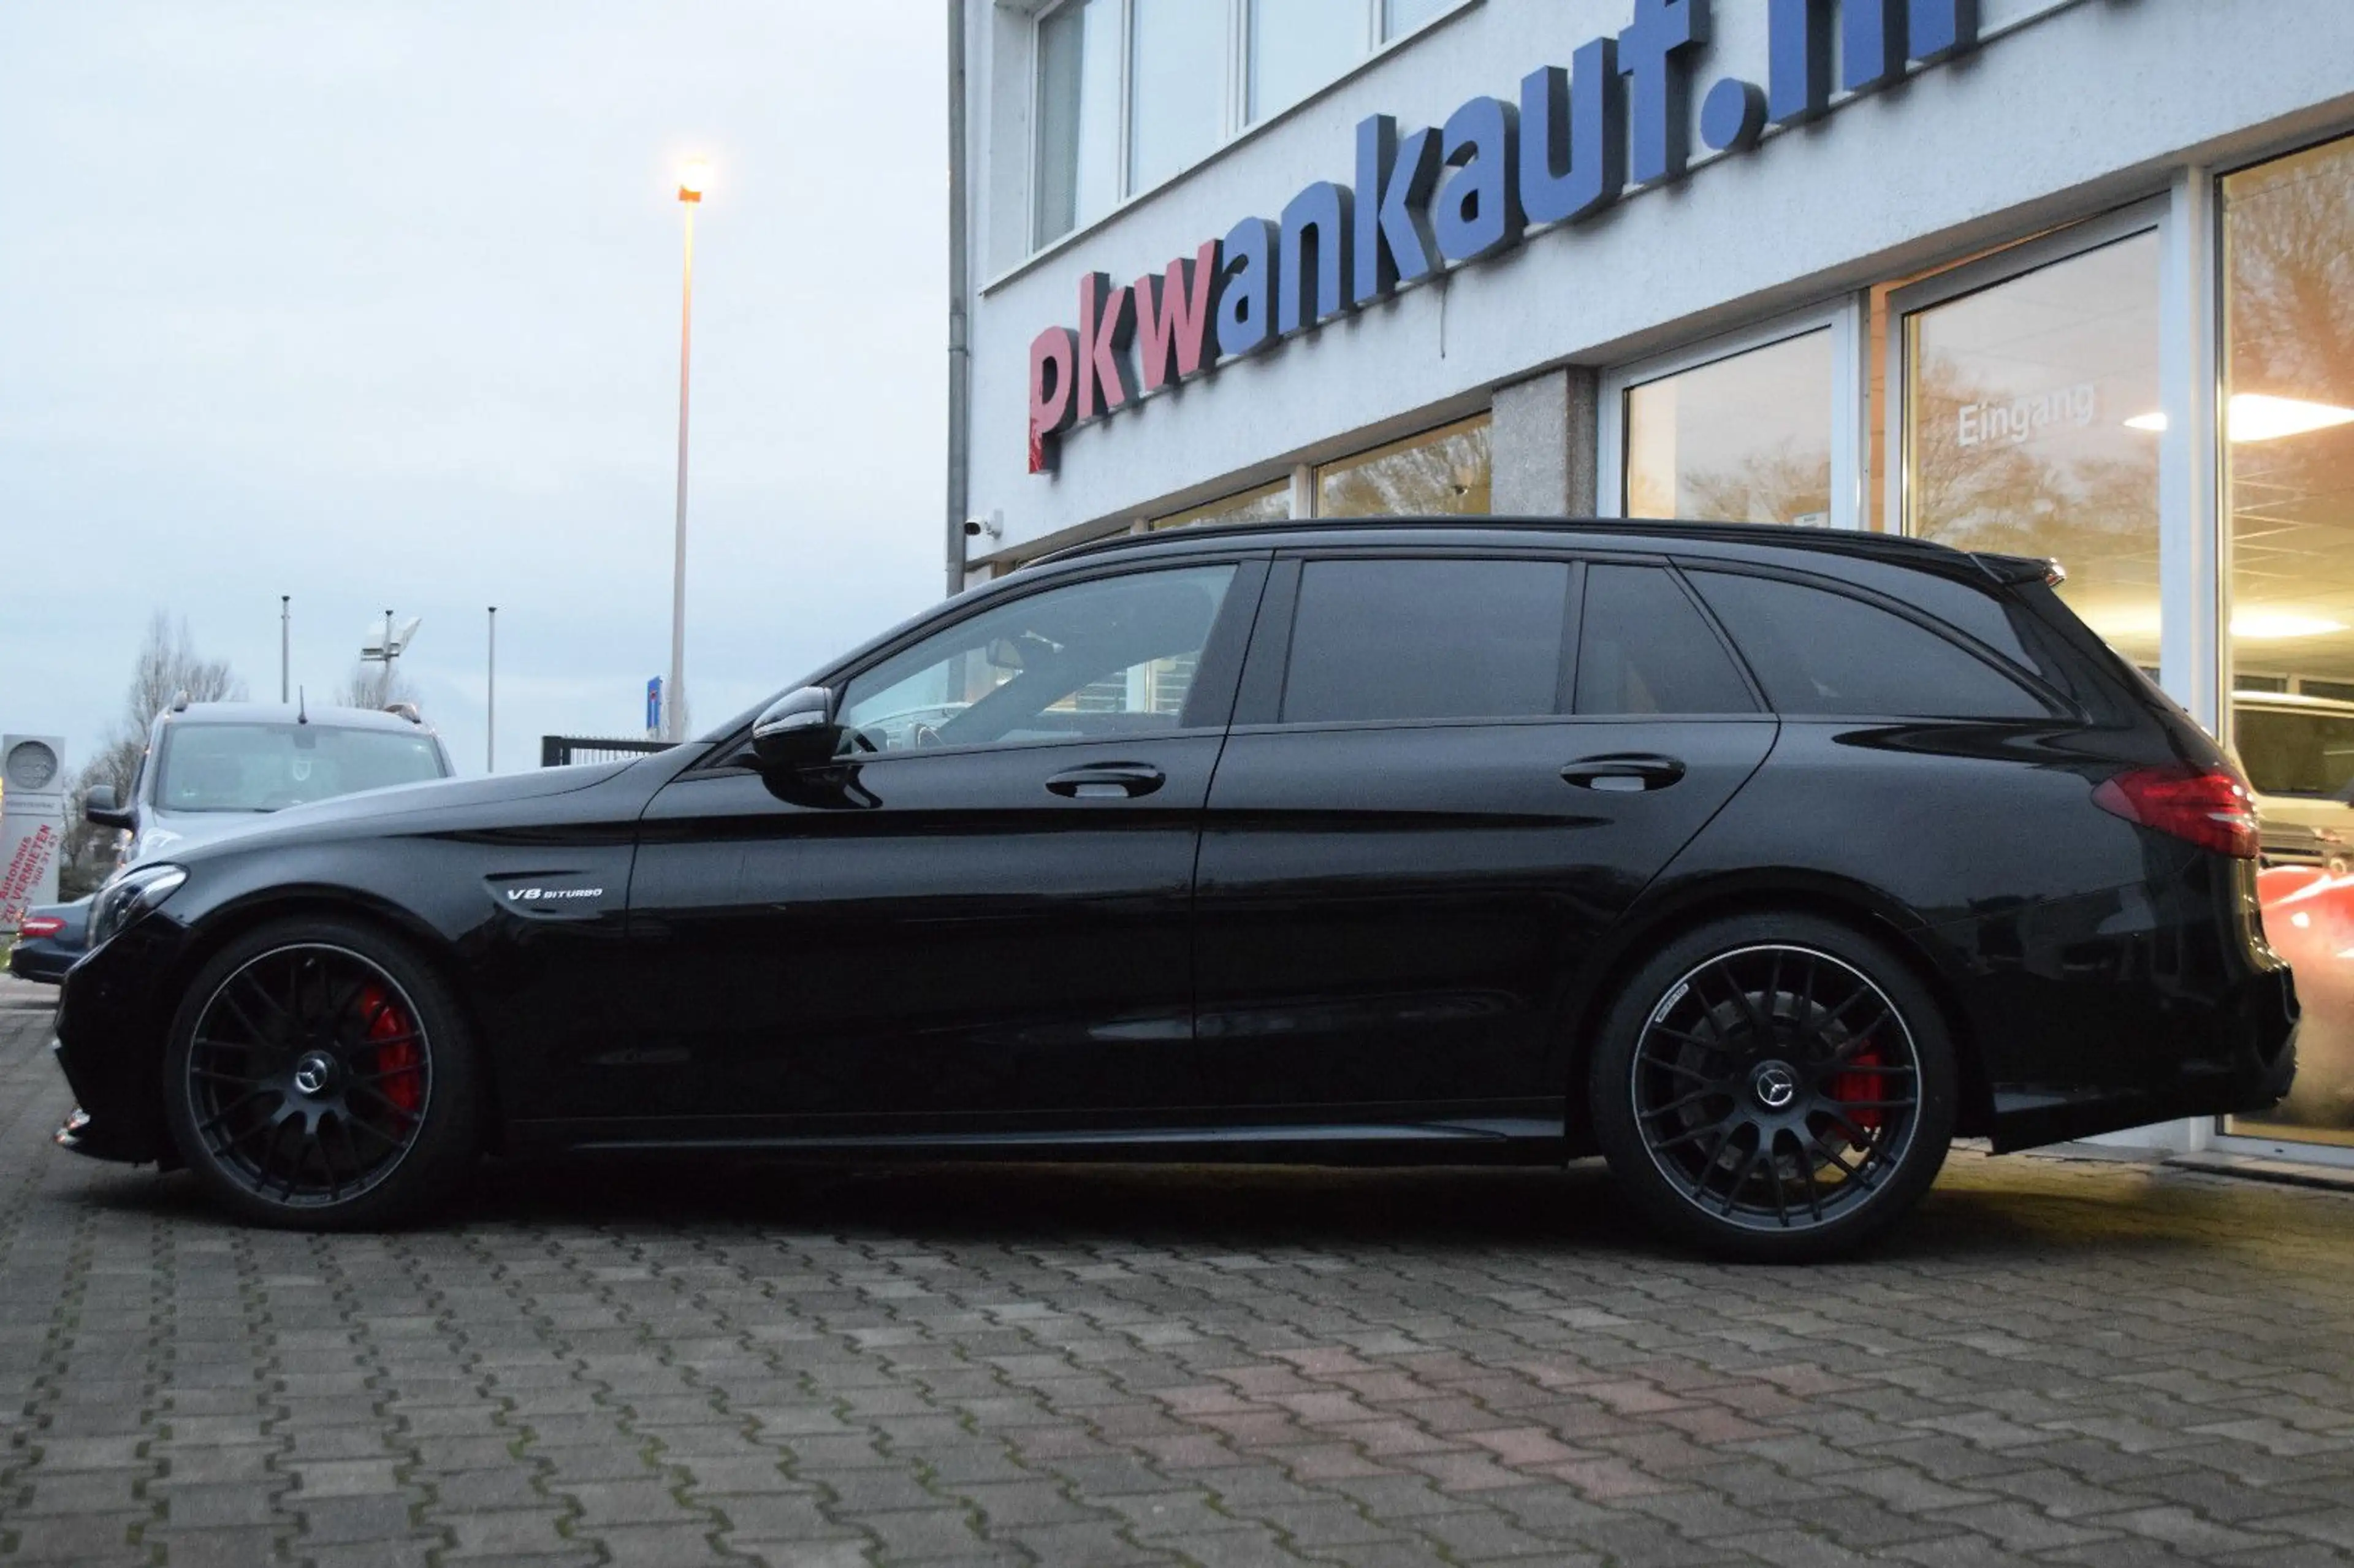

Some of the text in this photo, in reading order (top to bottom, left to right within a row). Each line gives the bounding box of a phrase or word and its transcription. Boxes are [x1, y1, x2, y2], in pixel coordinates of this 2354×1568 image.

[1958, 382, 2094, 447] Eingang
[12, 823, 51, 899] VERMIETEN
[508, 888, 603, 900] V8 BITURBO
